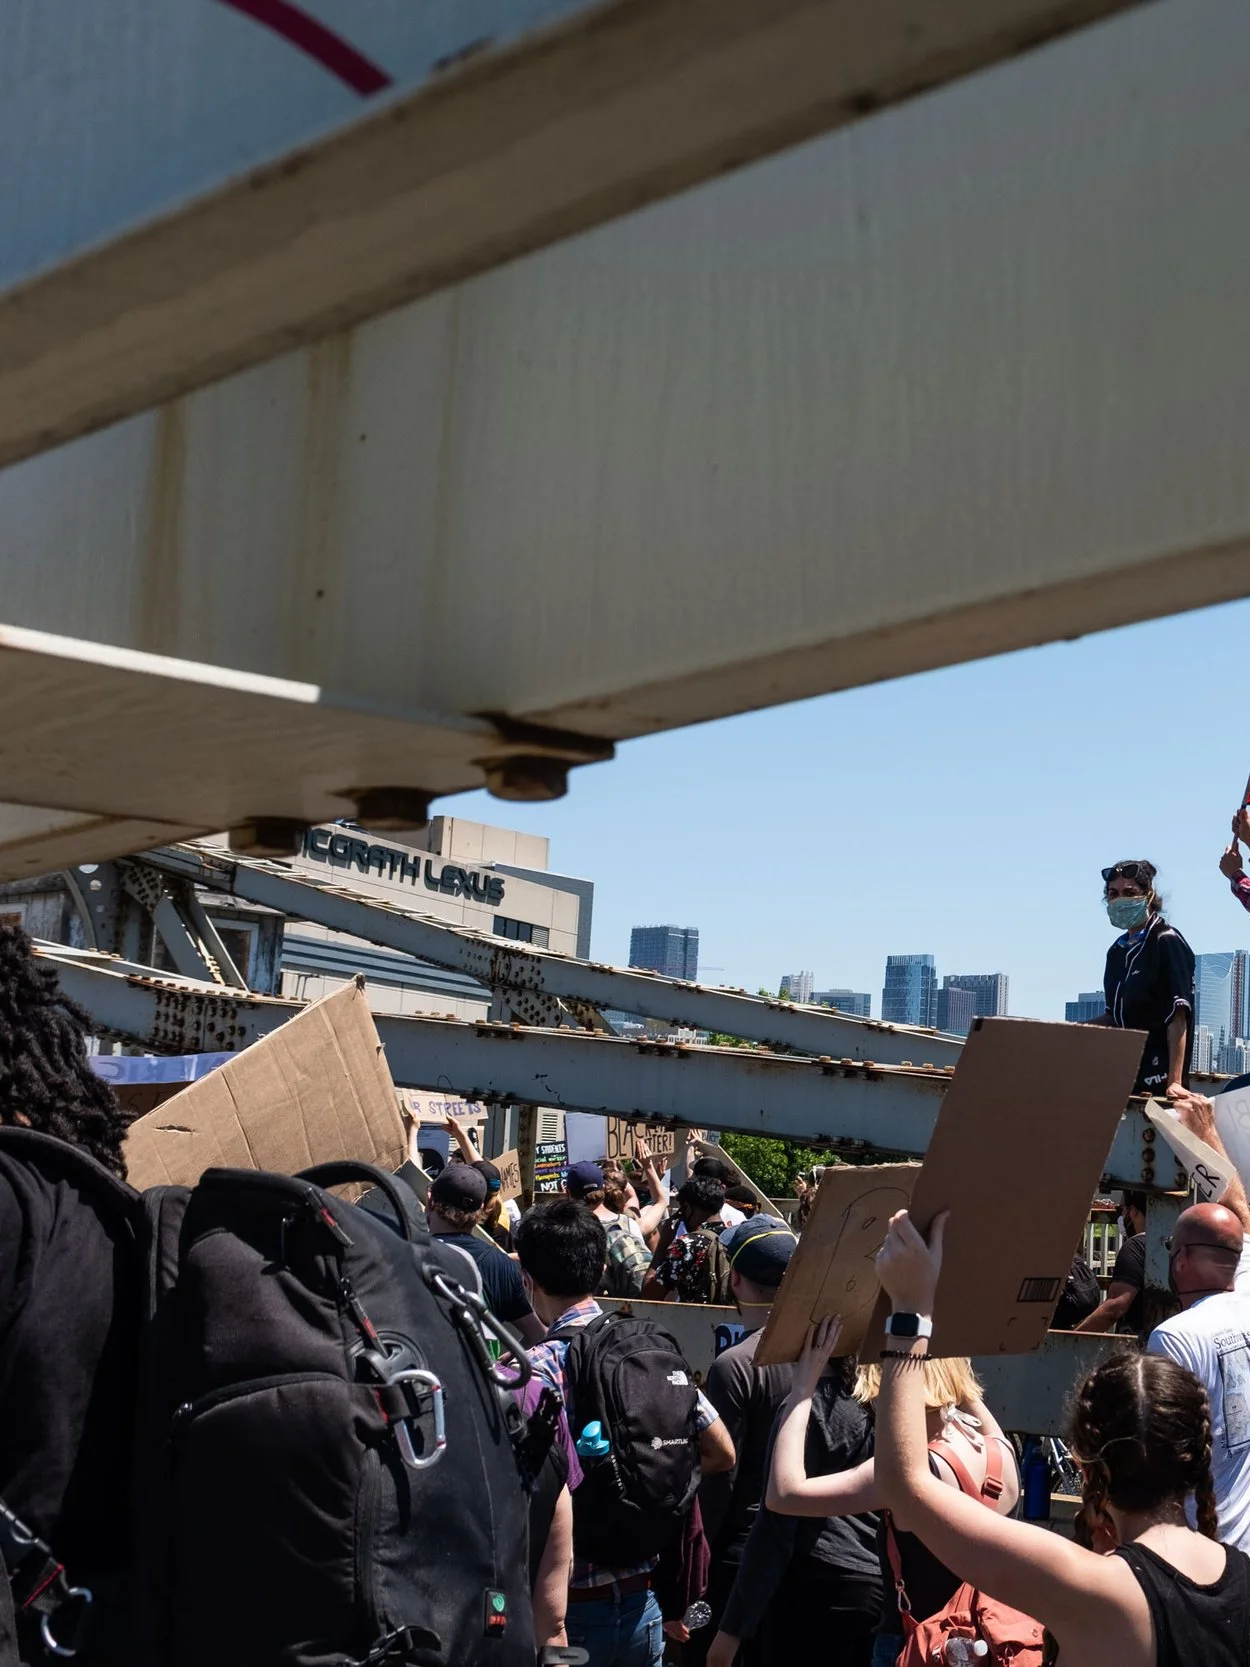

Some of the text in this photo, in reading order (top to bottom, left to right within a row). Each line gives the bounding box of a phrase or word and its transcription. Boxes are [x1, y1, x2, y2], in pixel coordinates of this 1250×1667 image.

[302, 827, 506, 903] CGRATH LEXUS
[429, 1100, 482, 1116] STREETS
[642, 1133, 672, 1153] TTER!
